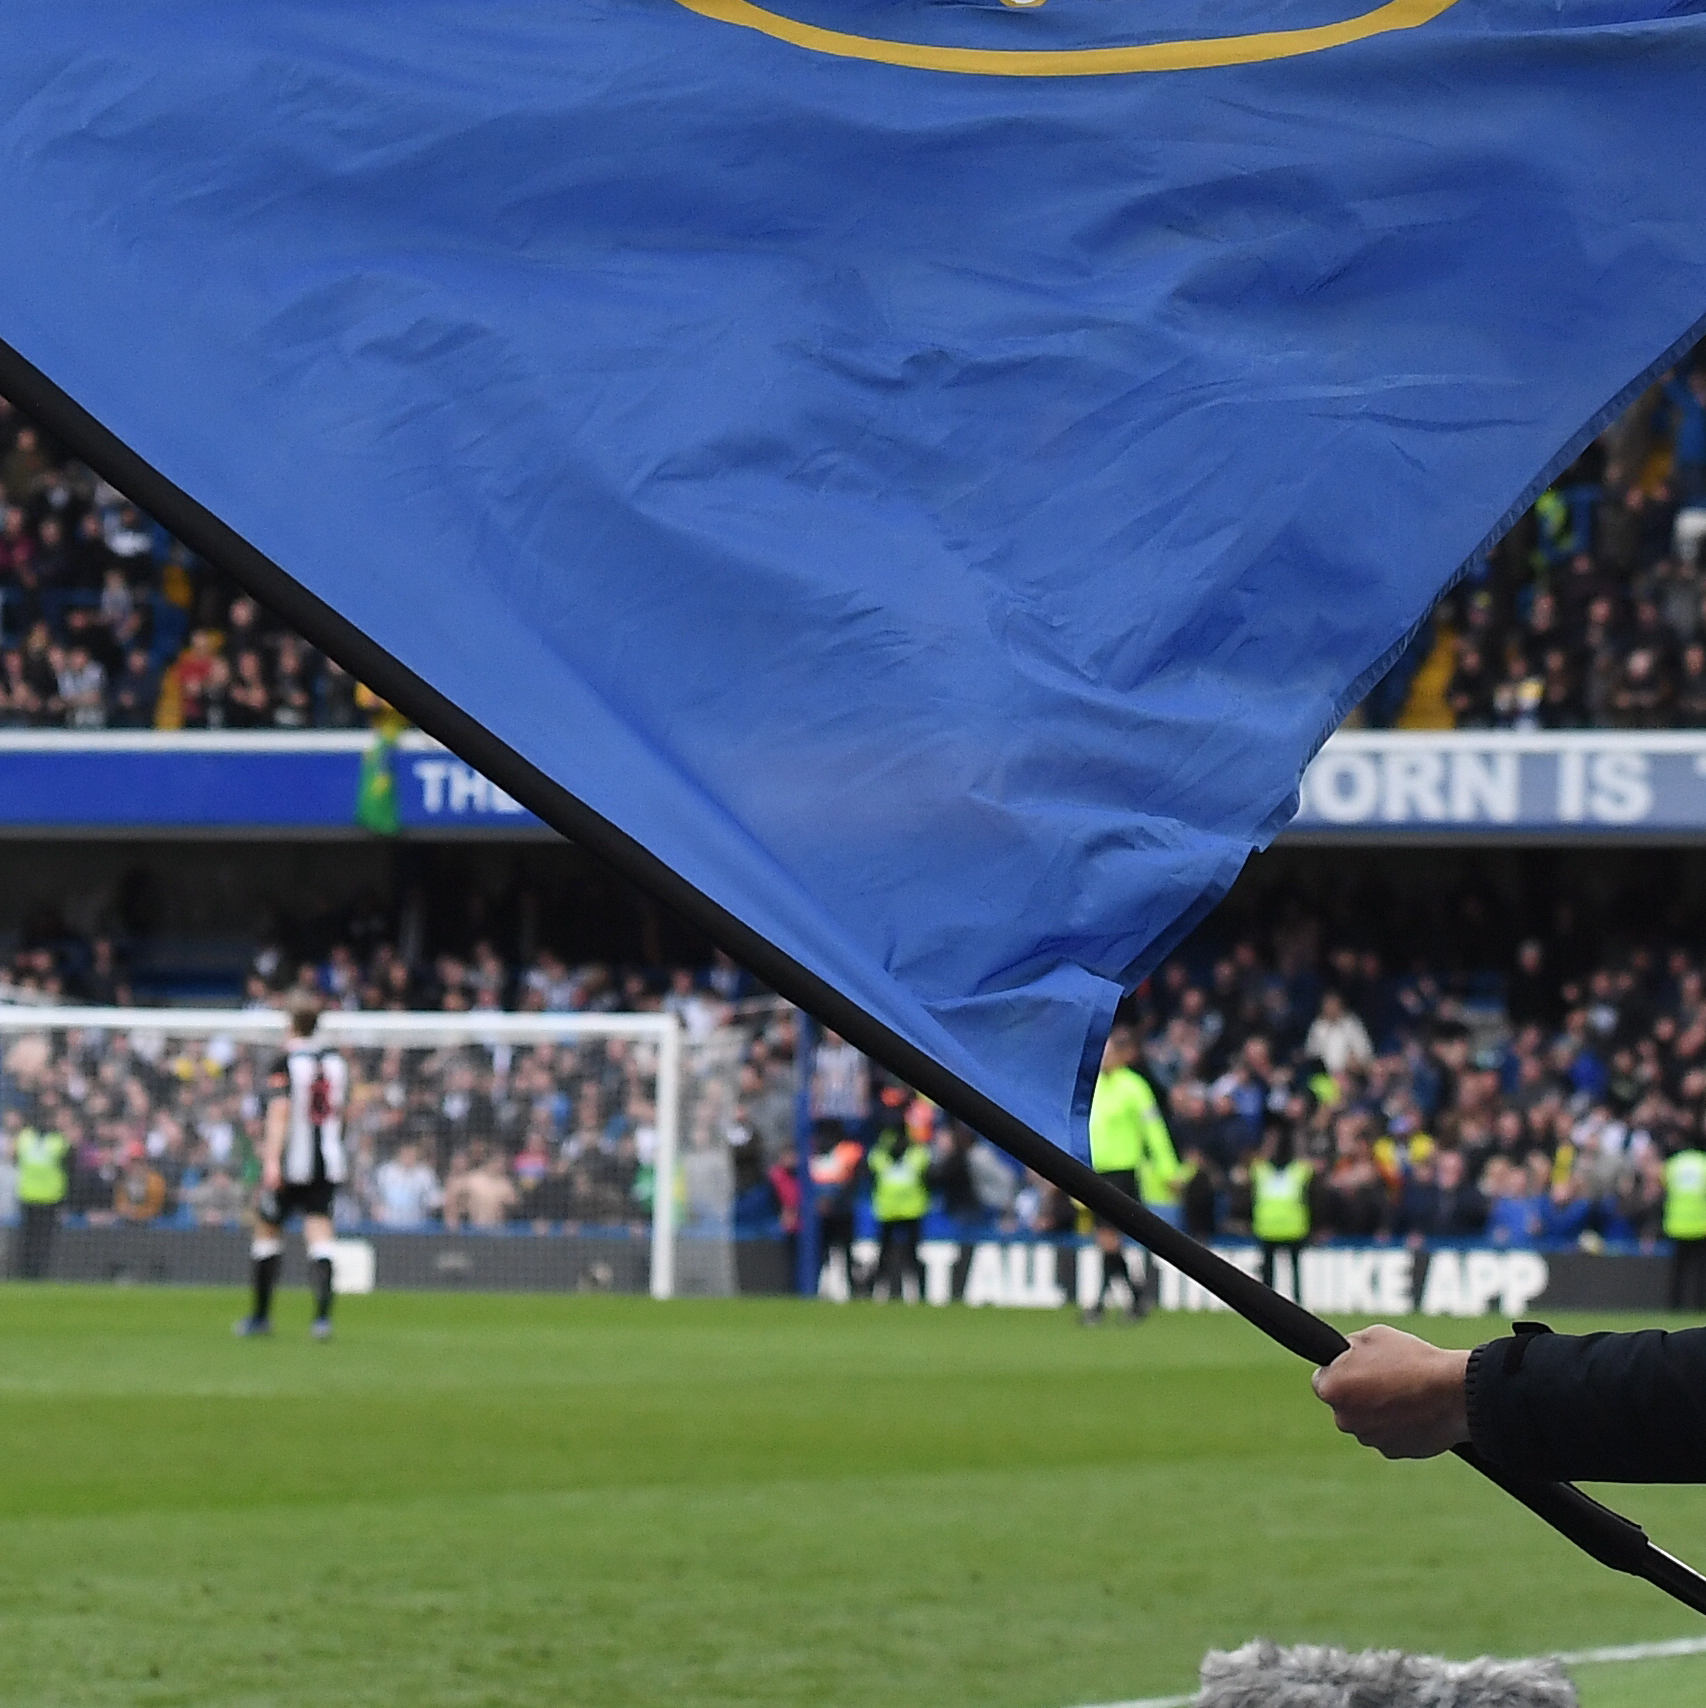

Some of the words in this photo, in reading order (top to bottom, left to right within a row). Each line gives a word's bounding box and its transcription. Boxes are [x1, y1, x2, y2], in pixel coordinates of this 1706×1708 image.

[1303, 753, 1518, 823] ORN
[1555, 754, 1654, 823] IS
[962, 1241, 1068, 1310] ALL
[1419, 1248, 1550, 1318] APP
